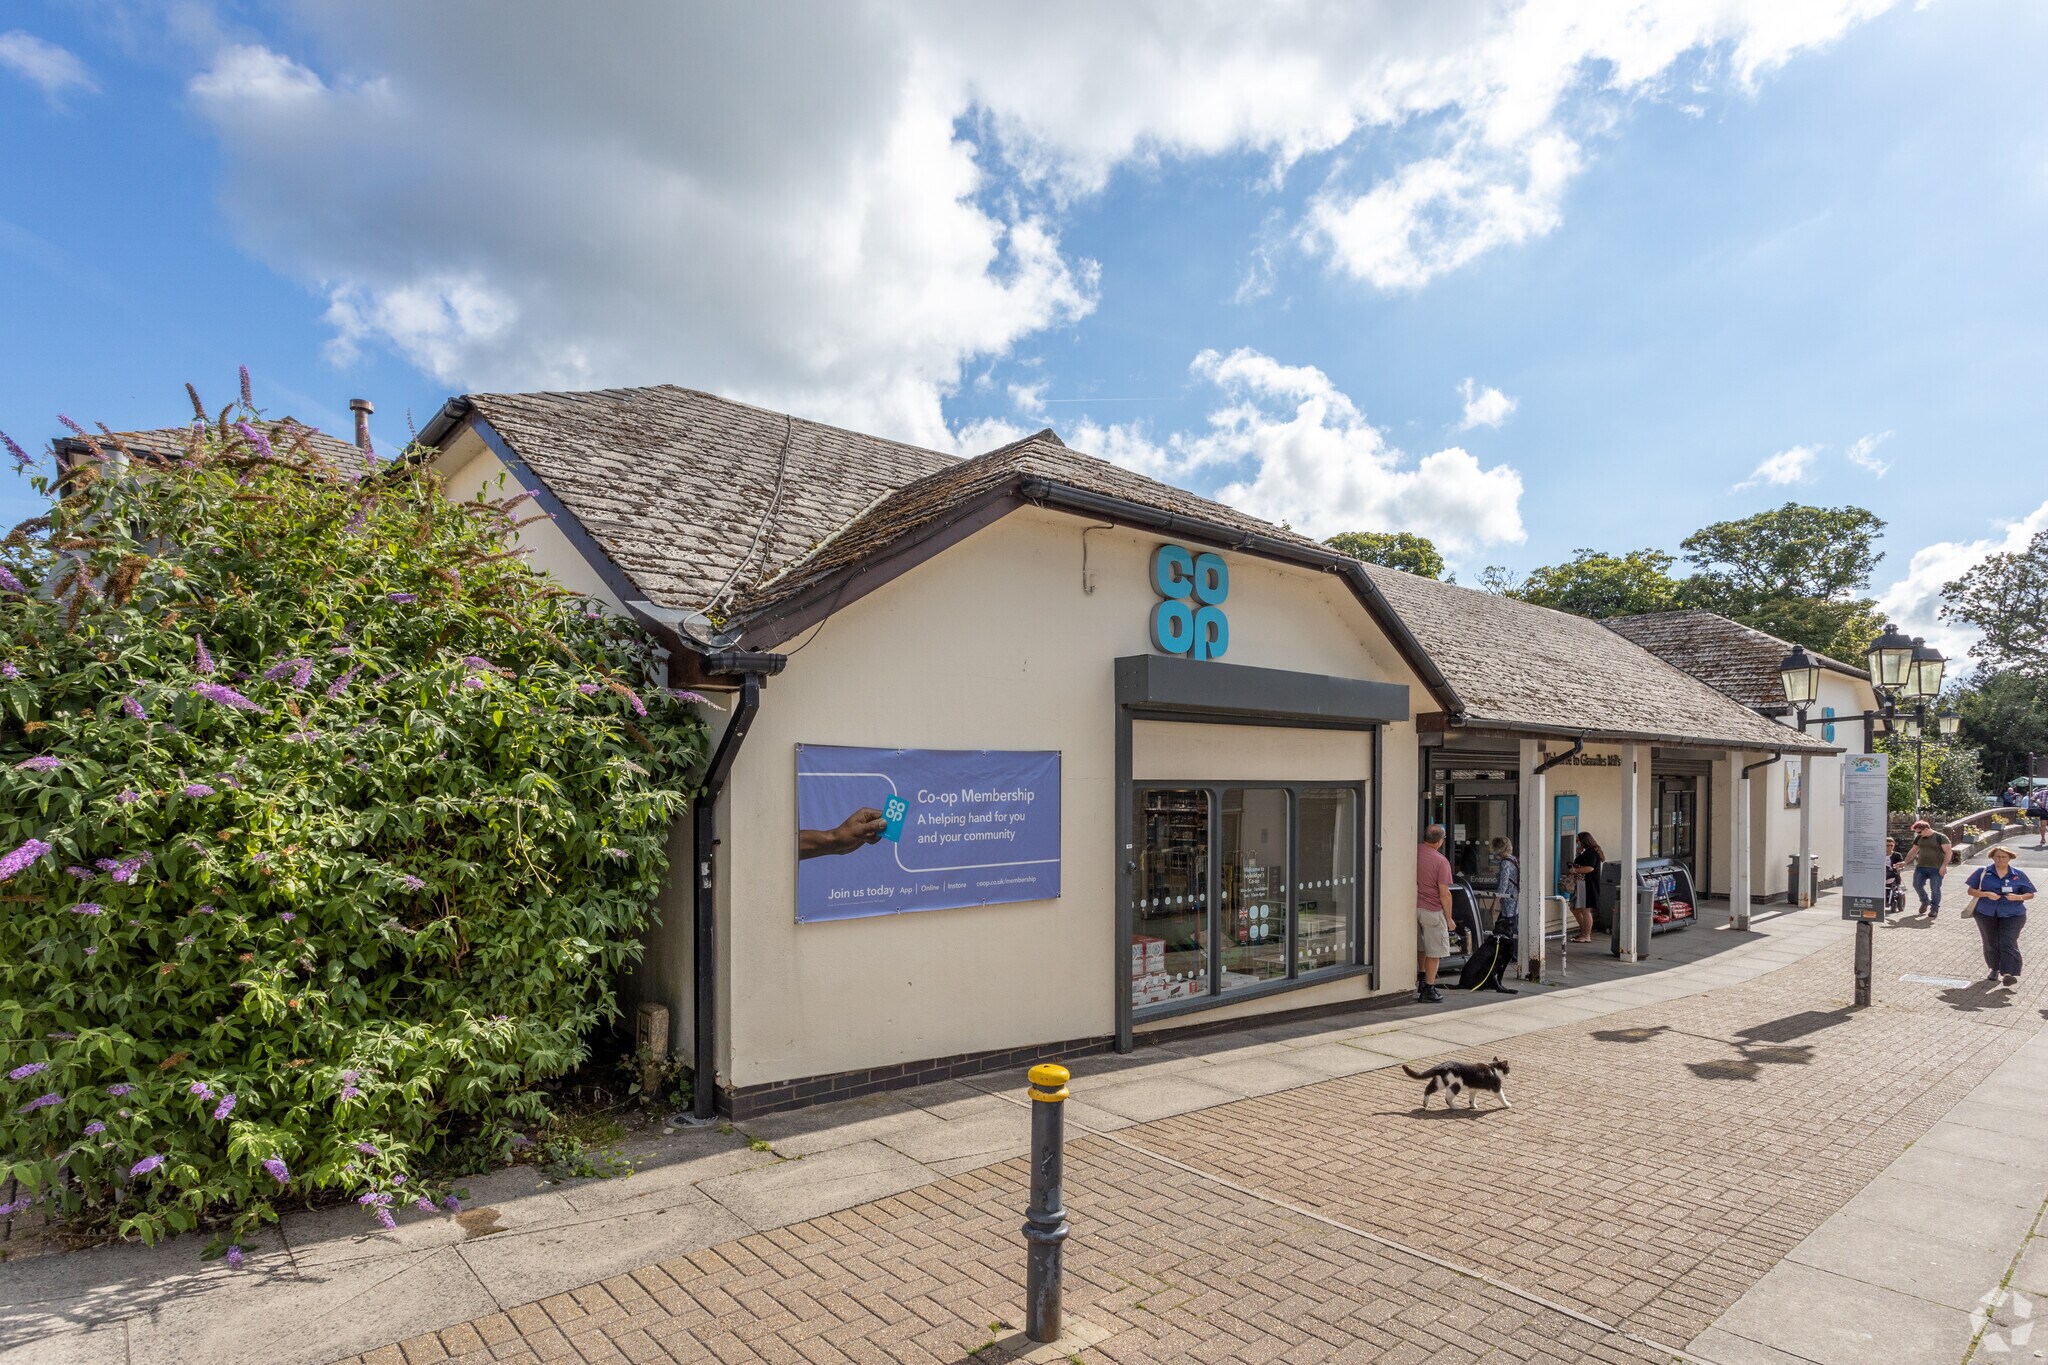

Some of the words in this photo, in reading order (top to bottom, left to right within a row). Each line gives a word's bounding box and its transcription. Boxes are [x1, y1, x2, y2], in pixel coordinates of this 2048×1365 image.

[917, 789, 958, 807] Co-op
[961, 788, 1035, 805] Membership
[917, 814, 926, 825] A
[928, 812, 966, 827] helping
[968, 811, 992, 823] hand
[994, 810, 1007, 822] for
[1009, 812, 1026, 825] you
[917, 831, 938, 844] and
[939, 833, 961, 846] your
[963, 828, 1016, 842] community
[899, 886, 913, 895] App
[920, 884, 940, 892] Online
[947, 882, 967, 890] Instore
[976, 875, 1037, 887] coop.co.uk/membership
[828, 888, 850, 900] Join
[853, 889, 865, 898] us
[866, 884, 895, 898] today
